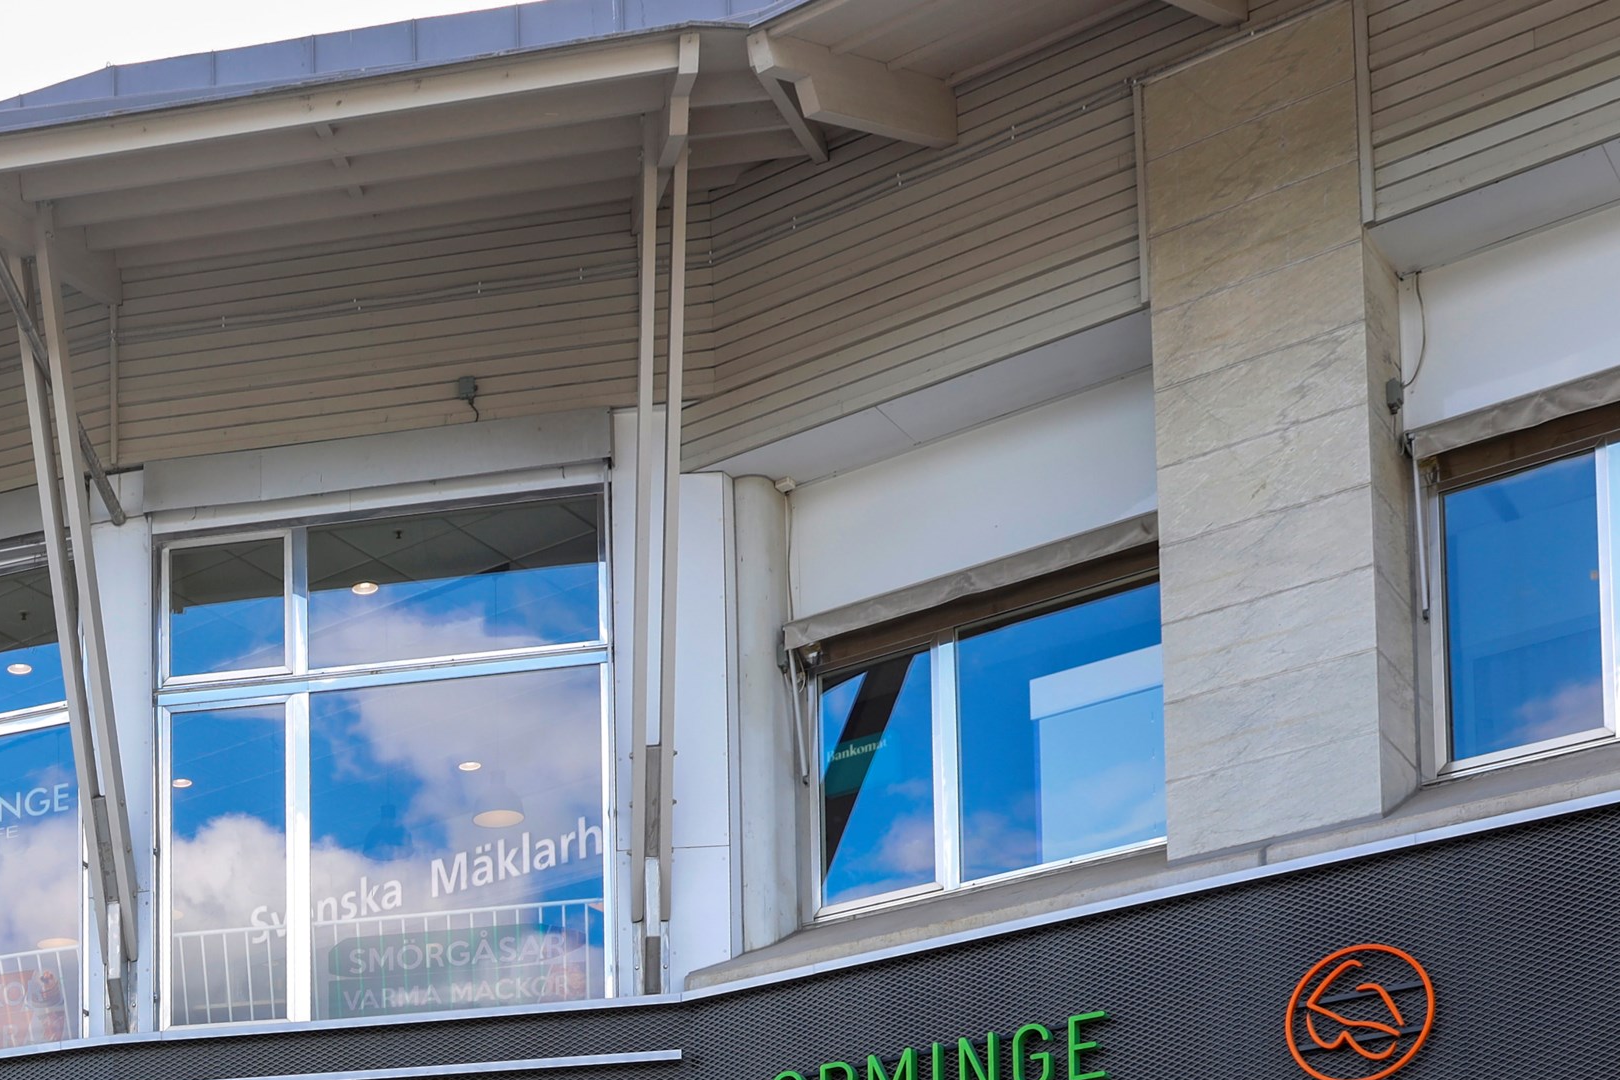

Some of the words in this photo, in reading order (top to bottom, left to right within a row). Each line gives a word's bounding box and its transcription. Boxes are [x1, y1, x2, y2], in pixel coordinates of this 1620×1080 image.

[250, 876, 402, 944] Svnska
[343, 985, 441, 1011] VARMA
[450, 974, 570, 1003] MACKOR
